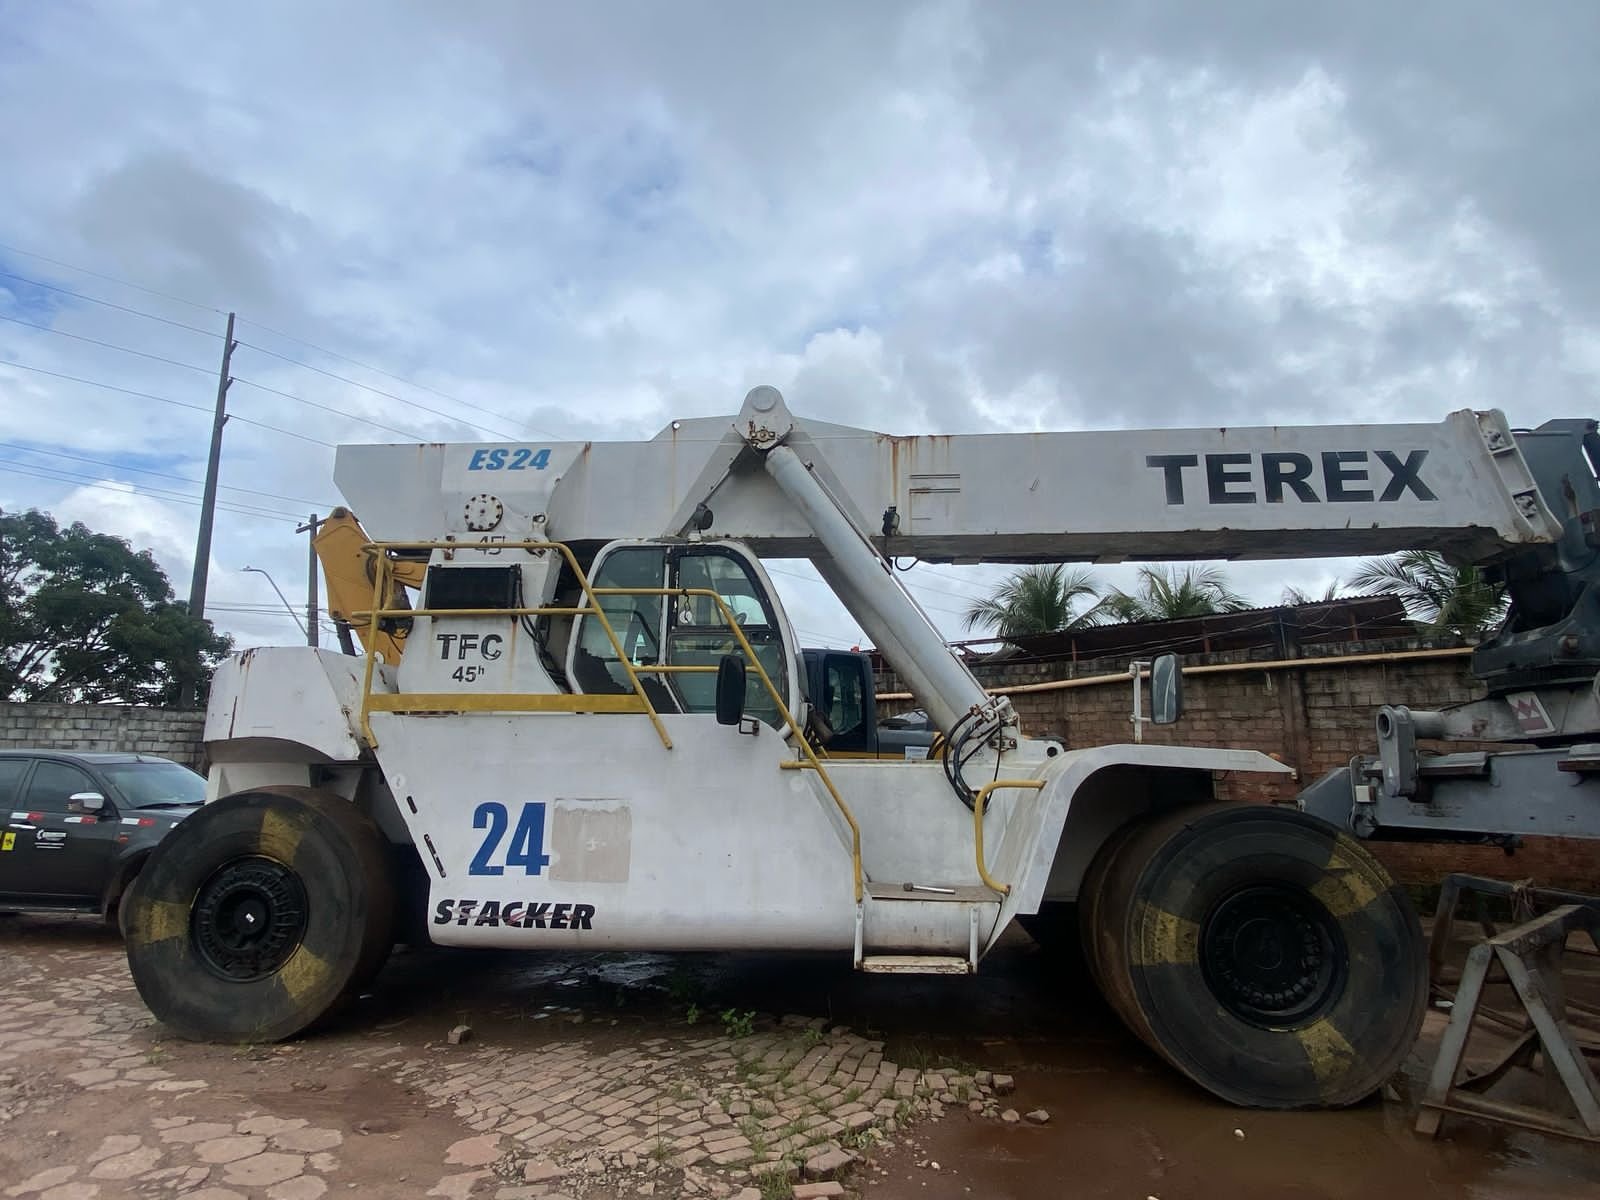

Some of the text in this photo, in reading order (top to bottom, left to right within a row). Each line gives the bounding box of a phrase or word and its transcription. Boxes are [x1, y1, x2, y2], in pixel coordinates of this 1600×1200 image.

[469, 449, 551, 471] ES24
[1146, 450, 1438, 505] TEREX
[437, 634, 503, 660] TFC
[469, 802, 549, 875] 24
[434, 899, 595, 929] STACKER
